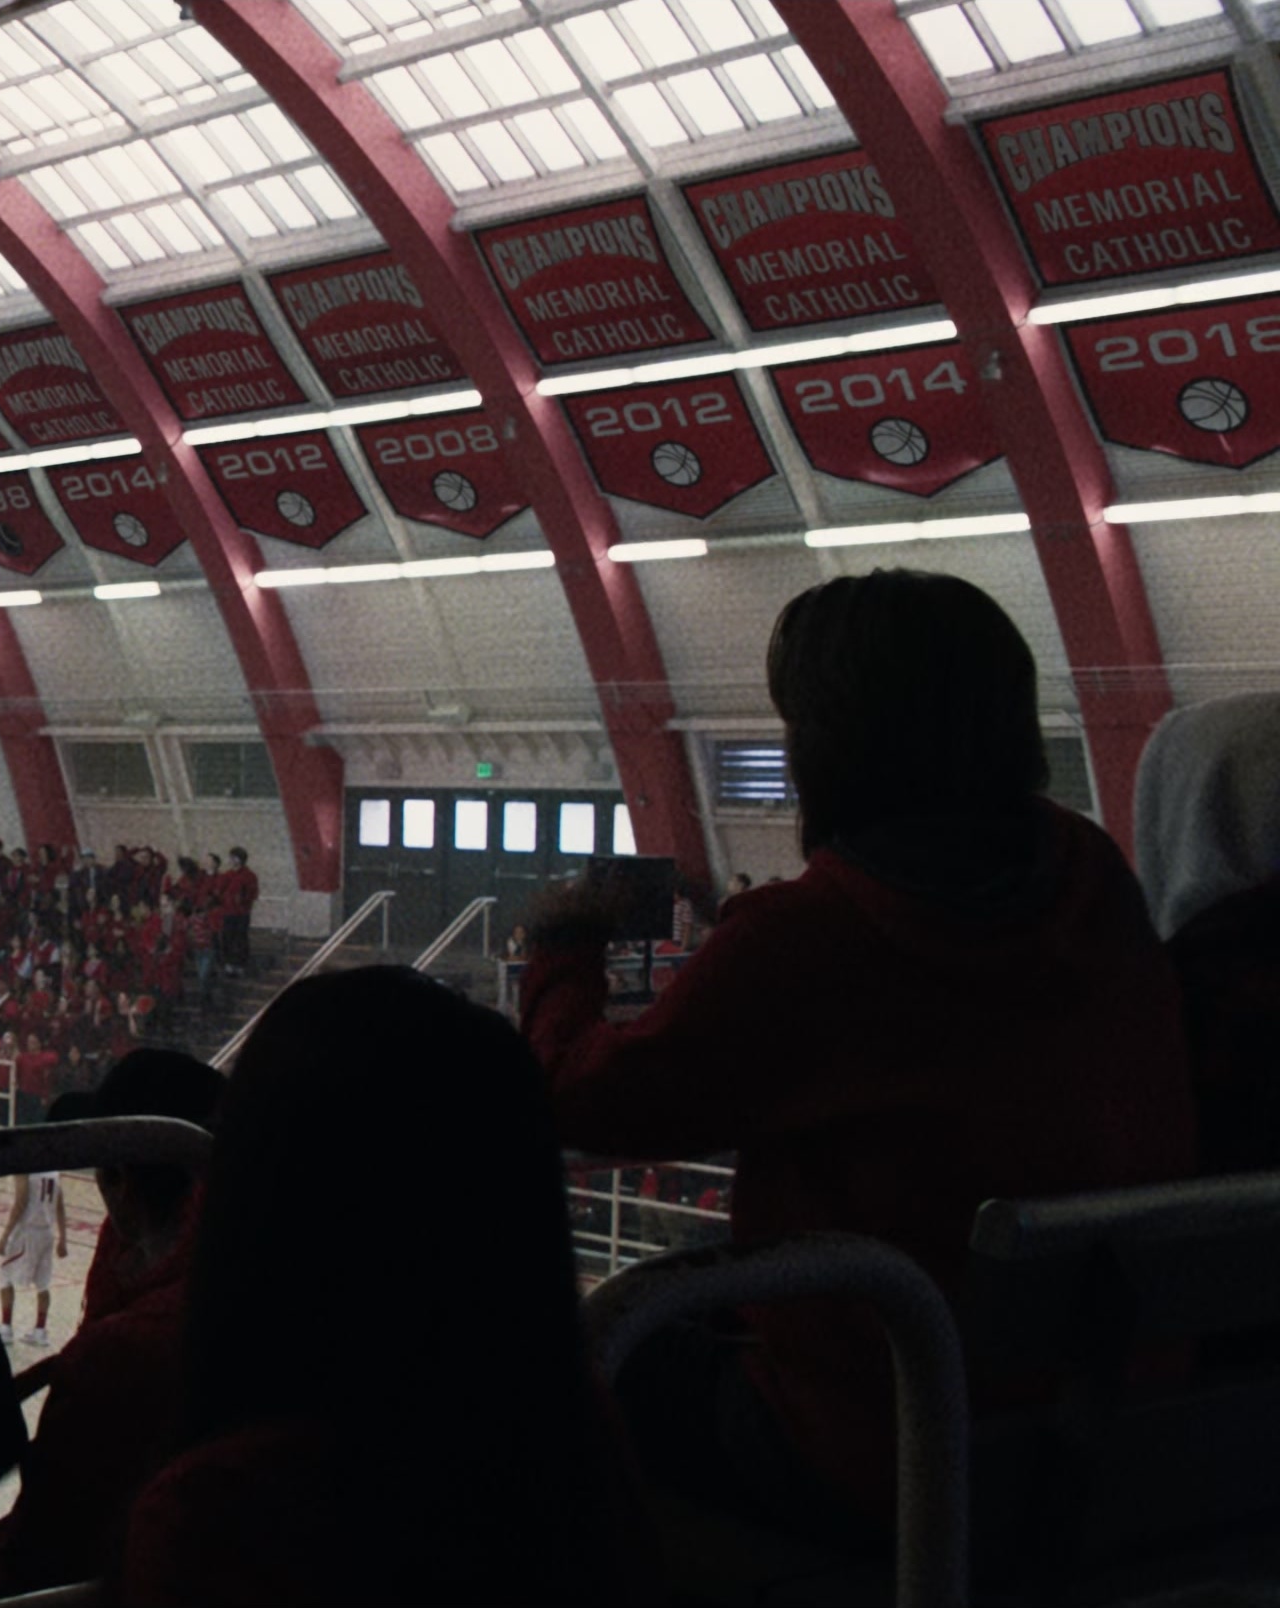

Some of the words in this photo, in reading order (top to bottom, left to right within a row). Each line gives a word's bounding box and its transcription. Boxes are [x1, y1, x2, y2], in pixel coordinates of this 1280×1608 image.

[996, 92, 1234, 192] CHAMPIONS
[700, 164, 896, 250] CHAMPIONS
[1033, 169, 1241, 233] MEMORIAL
[490, 213, 659, 290] CHAMPIONS
[735, 232, 907, 286] MEMORIAL
[1064, 218, 1252, 274] CATHOLIC
[281, 263, 425, 332] CHAMPIONS
[524, 274, 670, 323] MEMORIAL
[765, 274, 920, 323] CATHOLIC
[132, 297, 260, 356] CHAMPIONS
[312, 318, 436, 361] MEMORIAL
[552, 313, 686, 356] CATHOLIC
[163, 344, 271, 384] MEMORIAL
[339, 353, 453, 391] CATHOLIC
[795, 361, 967, 414] 2014
[5, 381, 101, 416] MEMORIAL
[186, 378, 286, 415] CATHOLIC
[585, 392, 733, 438] 2012
[30, 411, 118, 441] CATHOLIC
[376, 424, 500, 465] 2008
[62, 466, 155, 500] 2014
[218, 442, 328, 480] 2012
